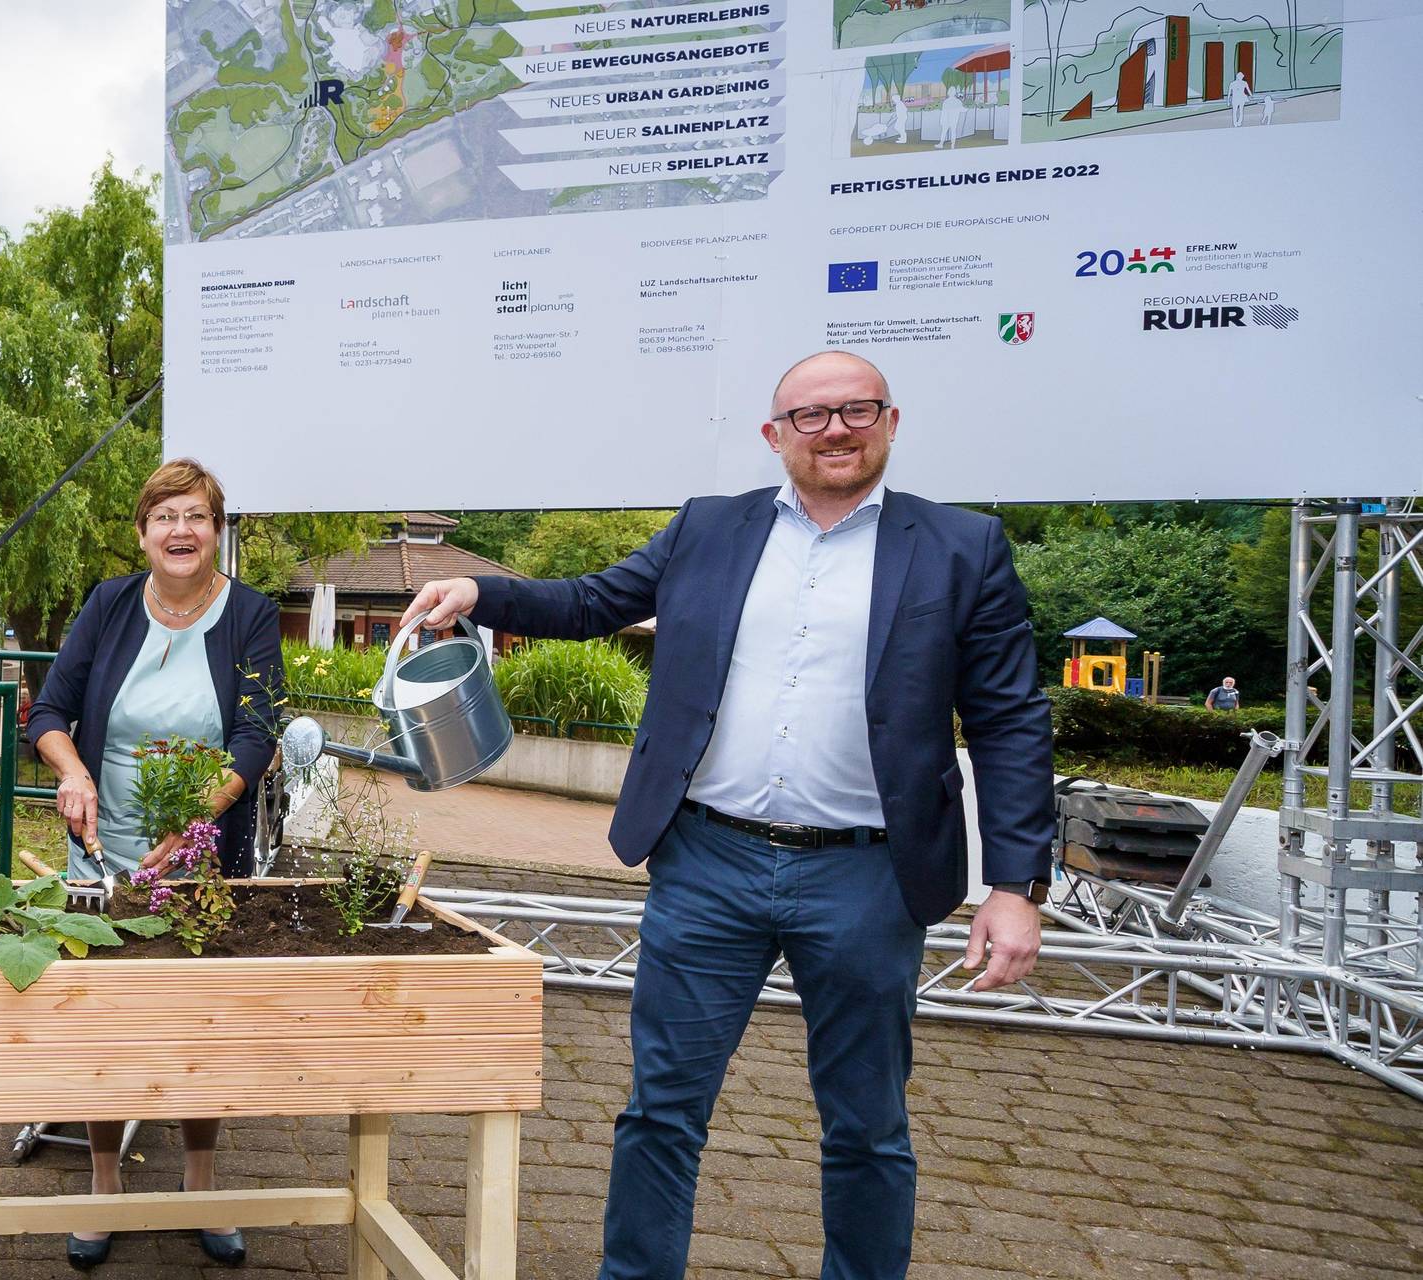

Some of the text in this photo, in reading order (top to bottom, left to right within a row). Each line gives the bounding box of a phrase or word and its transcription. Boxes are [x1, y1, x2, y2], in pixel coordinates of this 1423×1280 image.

[574, 3, 770, 34] NEUES NATURERLEBNIS
[525, 41, 770, 75] NEUE BEWEGUNGSANGEBOTE
[550, 79, 770, 108] NEUES URBAN GARDENING
[584, 115, 769, 141] NEUER SALINENPLATZ
[609, 152, 769, 176] NEUER SPIELPLATZ
[830, 164, 1100, 195] FERTIGSTELLUNG ENDE 2022
[829, 214, 1050, 236] GEFÖRDERT DURCH DIE EUROPÄISCHE UNION
[640, 238, 693, 248] BIODIVERSE
[1186, 243, 1238, 252] EFRE.NRW
[889, 254, 982, 267] EUROPÄISCHE UNION
[1186, 253, 1241, 262] Investitionen
[1253, 249, 1301, 258] Wachstum
[889, 266, 928, 274] Investition
[964, 262, 993, 270] Zukunft
[1186, 264, 1202, 272] und
[1204, 261, 1268, 271] Beschäftigung
[659, 274, 758, 286] Landschaftsarchitektur
[889, 273, 943, 283] Europäischer
[201, 281, 273, 292] REGIONALVERBAND
[502, 281, 527, 290] licht
[889, 279, 993, 291] für regionale Entwicklung
[495, 293, 527, 302] raum
[640, 290, 678, 298] München
[1143, 291, 1278, 307] REGIONALVERBAND
[201, 301, 229, 309] Susanne
[340, 294, 410, 309] Landschaft
[497, 302, 574, 314] stadt planung
[371, 310, 403, 320] planen
[411, 308, 440, 317] bauen
[1143, 306, 1247, 331] RUHR
[826, 321, 872, 329] Ministerium
[873, 319, 885, 327] für
[920, 315, 982, 325] Landwirtschaft,
[639, 325, 693, 334] Romanstraße
[869, 326, 942, 336] Verbraucherschutz
[493, 331, 571, 341] Richard-Wagner-Str.
[638, 335, 705, 344] 80639 München
[871, 333, 951, 343] Nordrhein-Westfalen
[339, 341, 370, 349] Friedhof
[493, 342, 557, 351] 42115 Wuppertal
[656, 344, 714, 353] 089-85631910
[362, 349, 400, 357] Dortmund
[510, 351, 562, 360] 0202-695160
